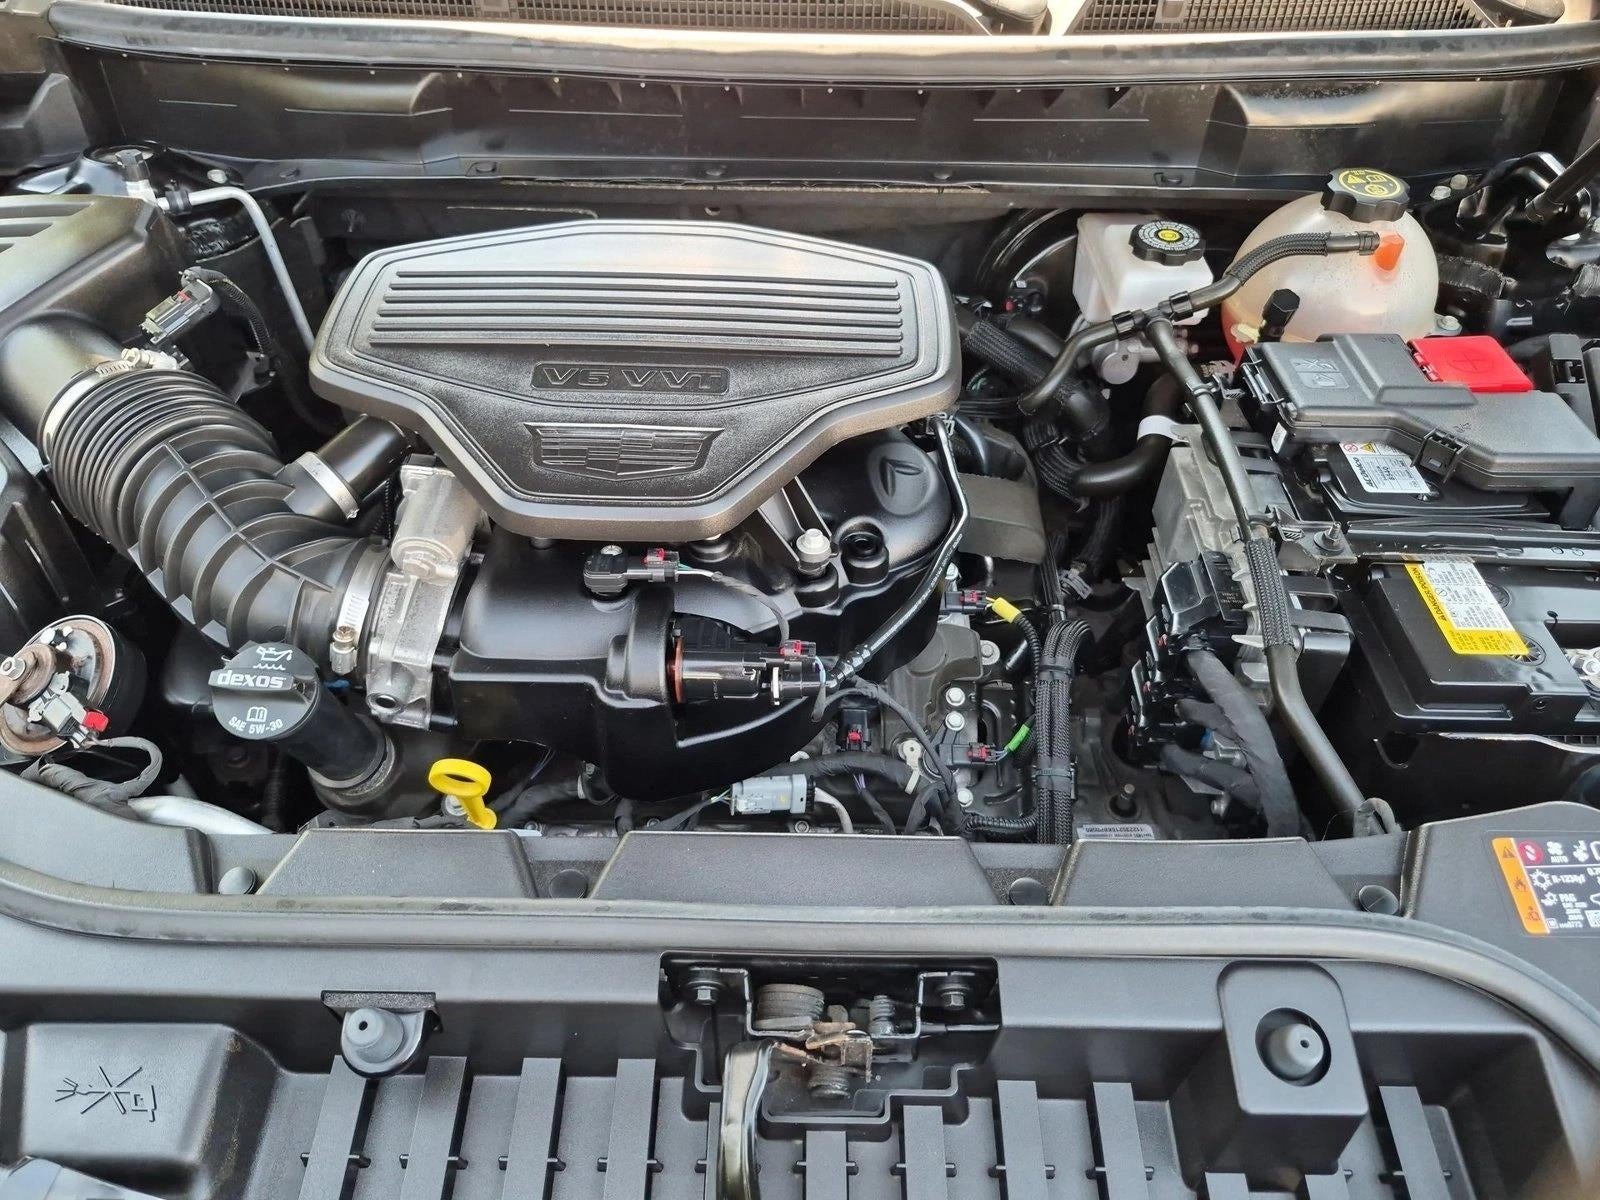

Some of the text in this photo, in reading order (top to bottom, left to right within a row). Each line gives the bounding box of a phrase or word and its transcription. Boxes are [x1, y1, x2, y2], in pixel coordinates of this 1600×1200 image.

[542, 367, 721, 389] V6 VVT
[217, 670, 284, 689] dexos
[228, 716, 283, 734] SAE 5W-30
[1550, 855, 1569, 863] AUTO
